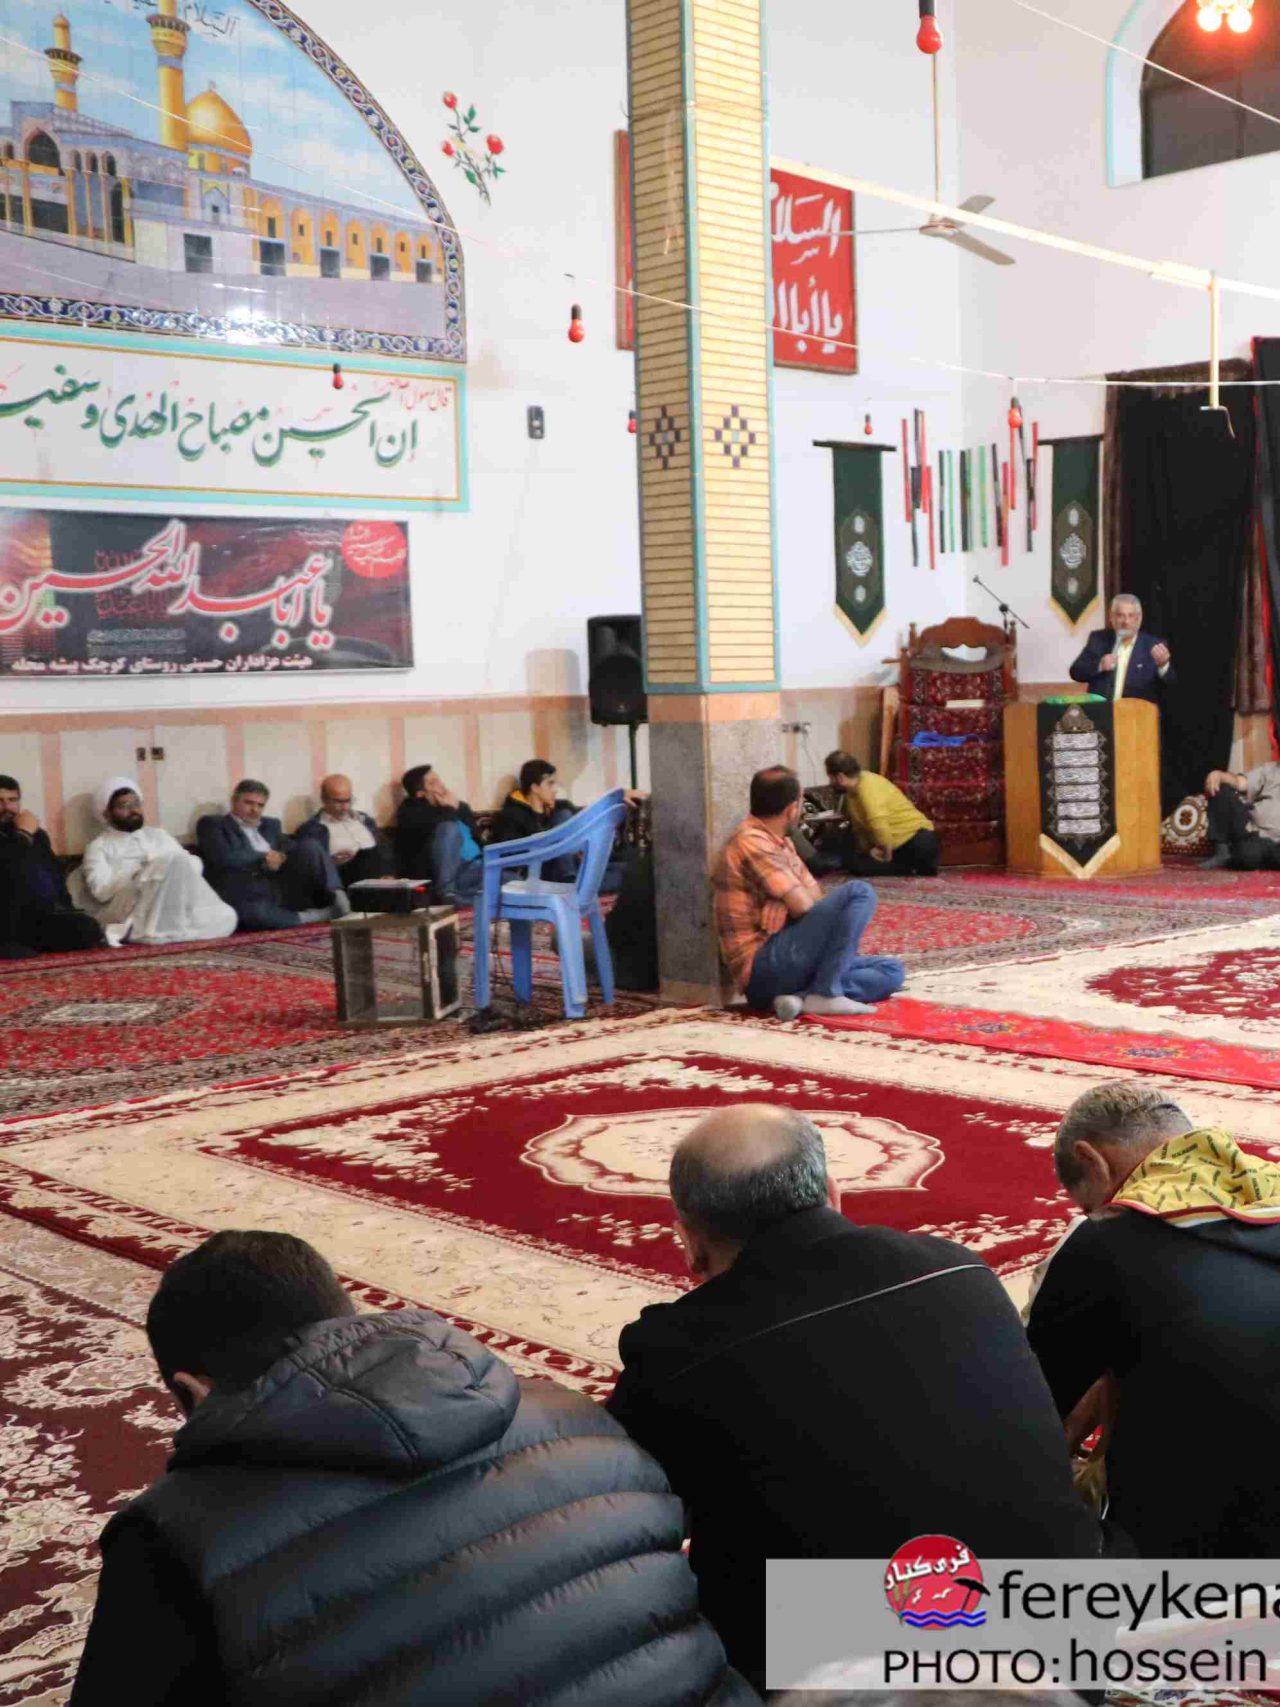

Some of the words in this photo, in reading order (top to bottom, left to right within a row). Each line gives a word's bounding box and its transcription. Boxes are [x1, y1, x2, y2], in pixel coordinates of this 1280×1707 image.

[80, 403, 100, 430] و
[177, 401, 270, 462] مصباح
[11, 657, 46, 672] محله
[82, 656, 126, 674] کوچک
[128, 656, 178, 674] روستای
[180, 657, 223, 673] حسینی
[225, 654, 280, 672] عزاداران
